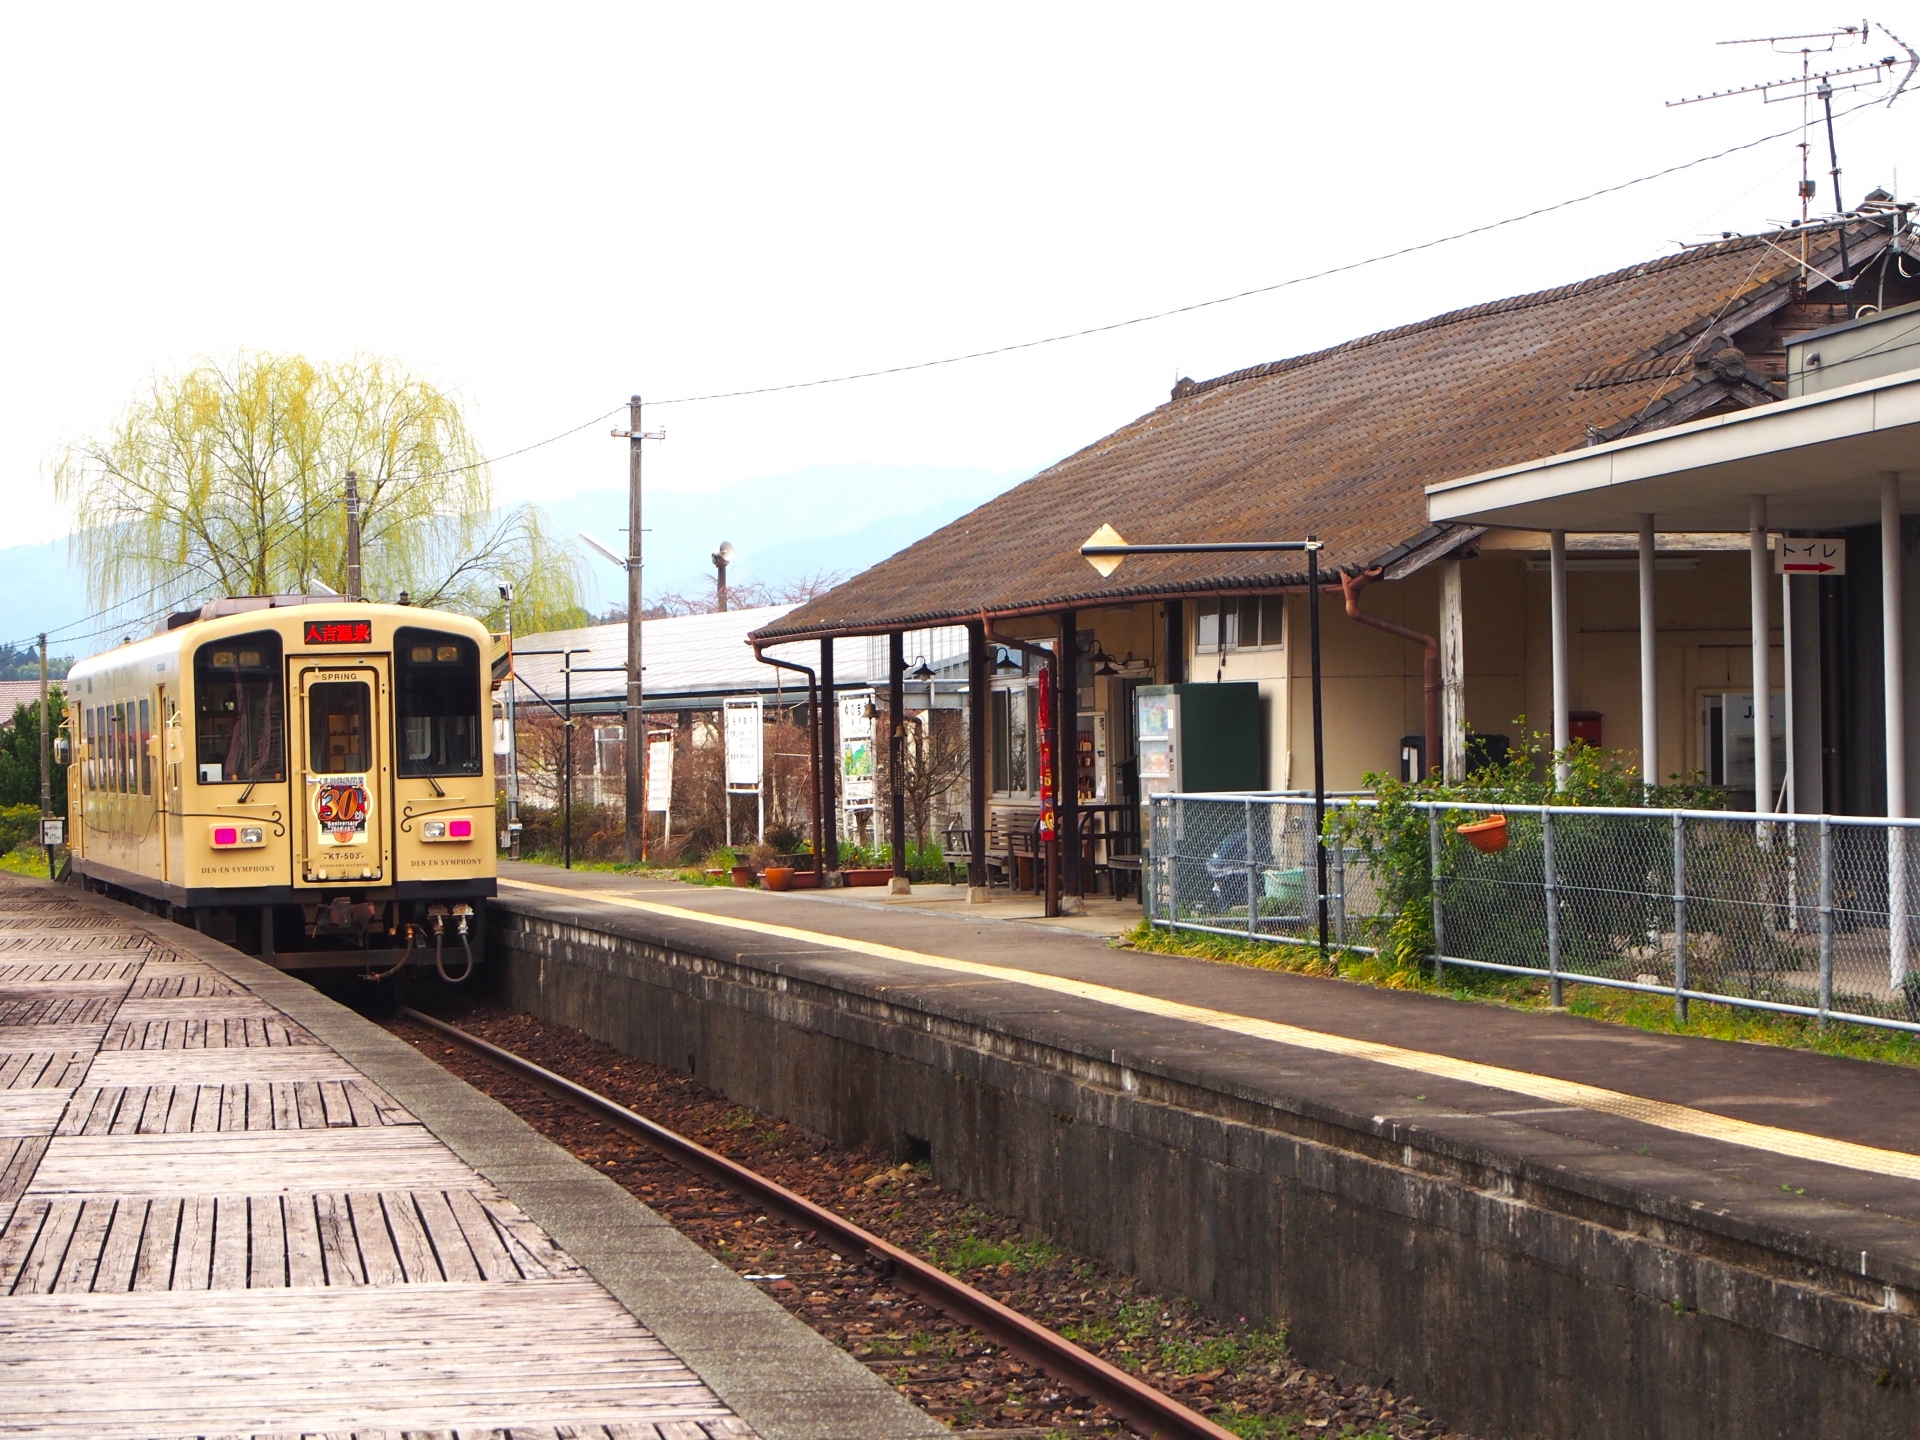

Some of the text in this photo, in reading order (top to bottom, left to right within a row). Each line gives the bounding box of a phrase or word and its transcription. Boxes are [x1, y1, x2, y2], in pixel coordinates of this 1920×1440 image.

[1783, 543, 1837, 558] トイレ
[305, 624, 370, 642] 人吉温泉
[321, 673, 357, 681] SPRING
[440, 858, 482, 866] SYMPHONY
[232, 865, 276, 873] SYMPHONY
